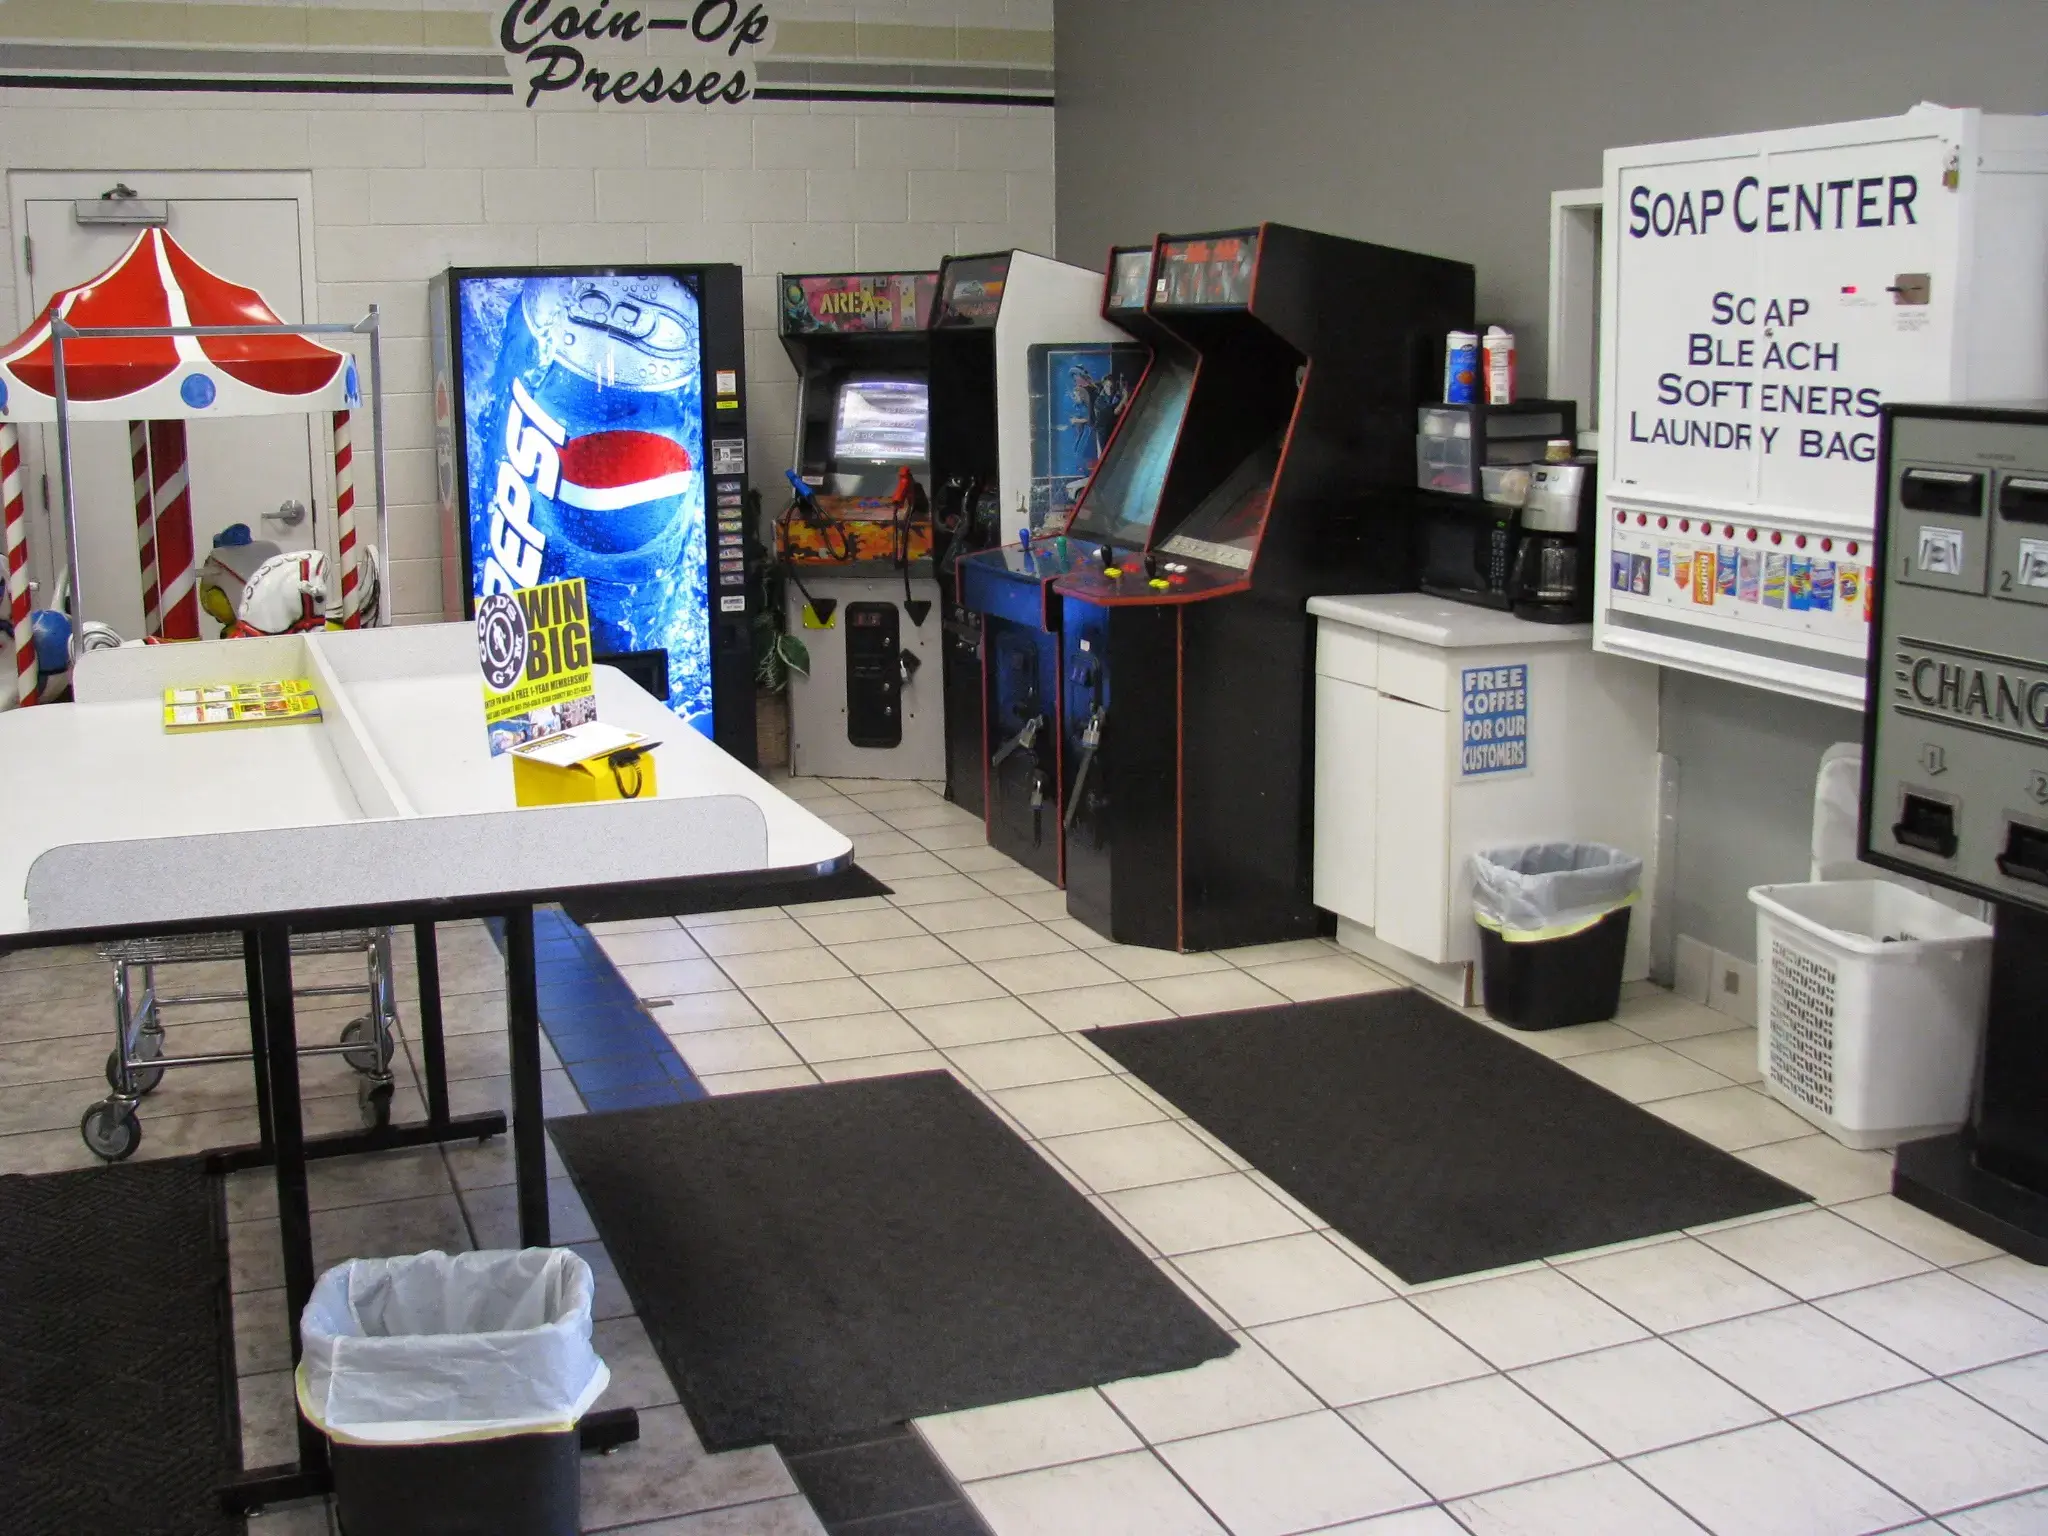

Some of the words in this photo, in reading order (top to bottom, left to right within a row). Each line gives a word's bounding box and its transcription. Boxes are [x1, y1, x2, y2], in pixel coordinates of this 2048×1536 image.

[525, 44, 750, 108] Presses
[1629, 186, 1724, 239] SOAP
[1733, 174, 1918, 234] CENTER
[819, 291, 876, 315] AREA
[1688, 333, 1840, 372] BLEACH
[1657, 373, 1881, 418] SOFTENERS
[1630, 411, 1779, 455] LAUNDRY
[2000, 570, 2012, 592] 2
[517, 580, 585, 631] WIN
[479, 595, 517, 663] GOLD'S
[491, 633, 524, 684] GYM
[525, 622, 589, 681] BIG
[516, 688, 529, 700] FREE
[530, 683, 550, 697] 1-YEAR
[1464, 668, 1522, 692] FREE
[1464, 689, 1525, 715] COFFEE
[1464, 719, 1492, 742] FOR
[1495, 715, 1525, 739] OUR
[1463, 740, 1524, 771] CUSTOMERS
